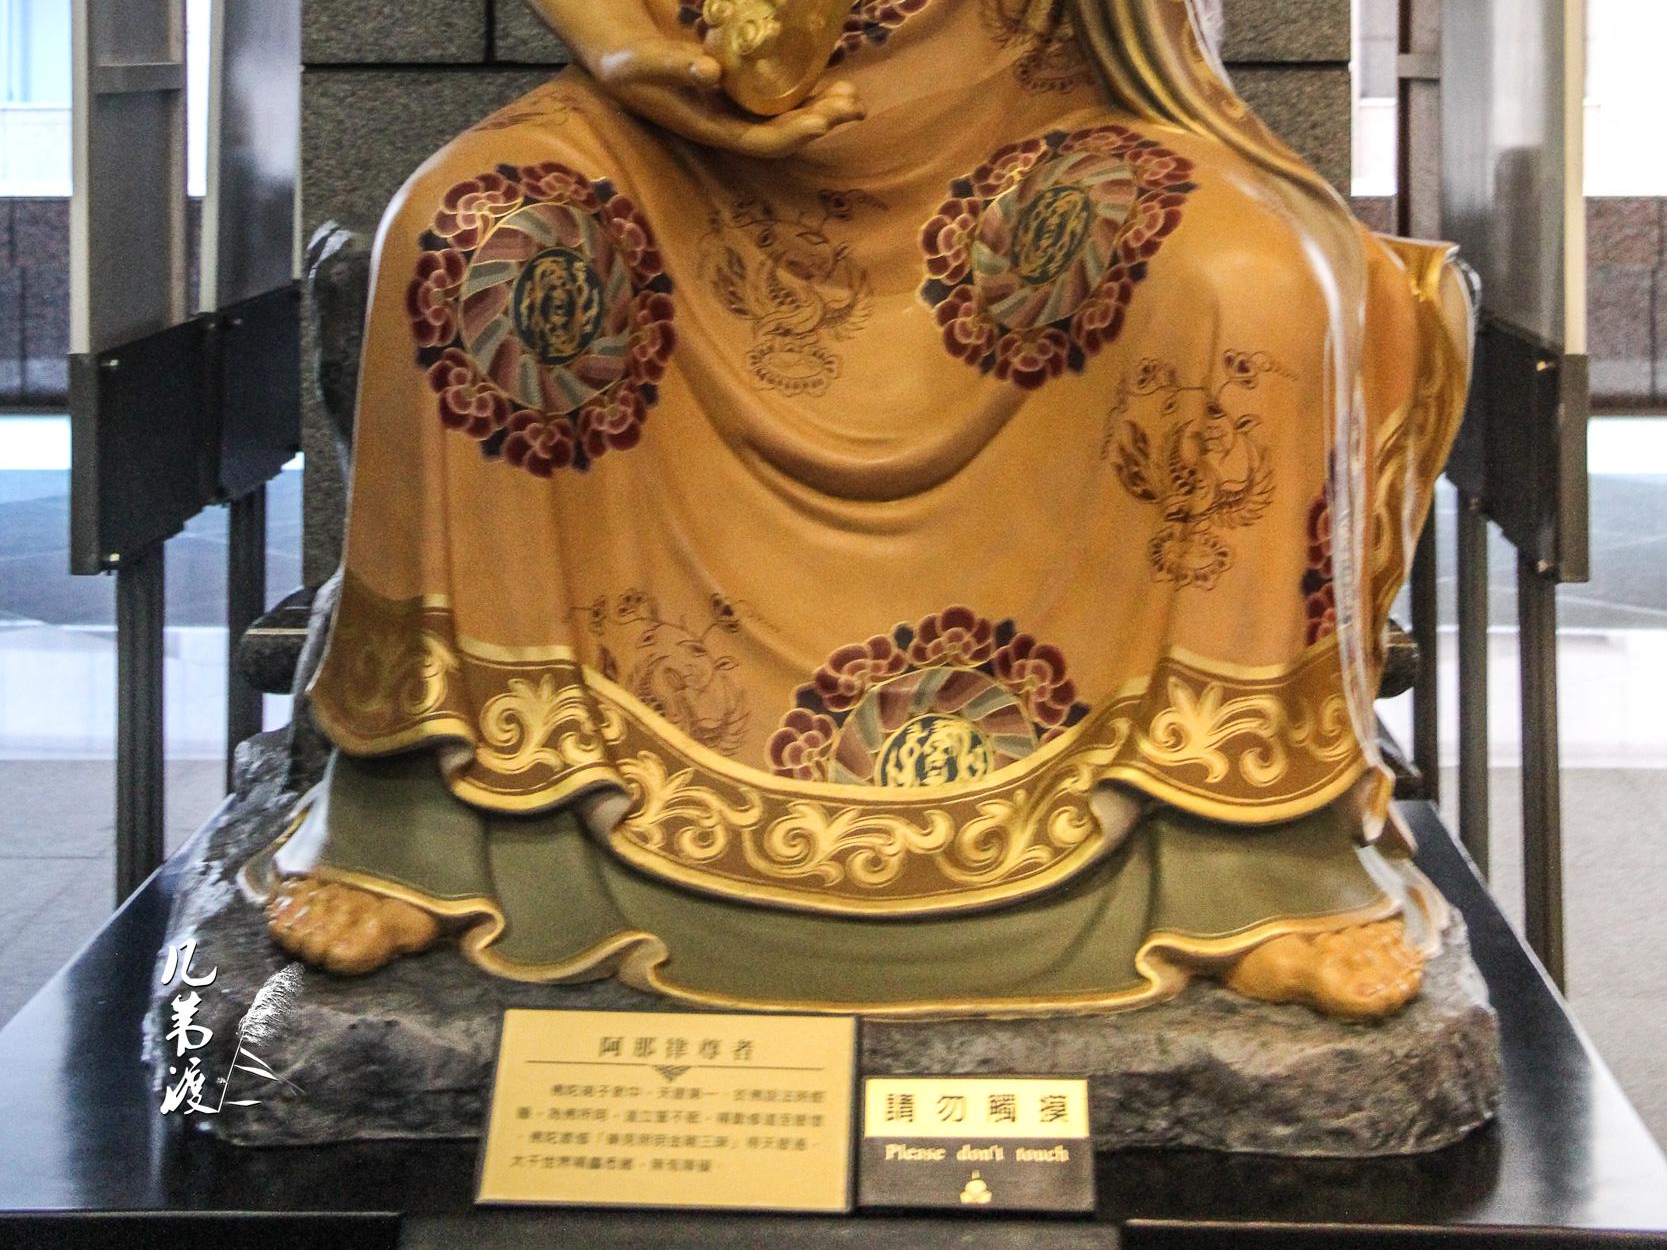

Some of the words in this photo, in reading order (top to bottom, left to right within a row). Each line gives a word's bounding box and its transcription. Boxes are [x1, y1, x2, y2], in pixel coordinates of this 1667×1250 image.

[885, 1093, 1070, 1123] 請勿觸摸
[885, 1143, 946, 1161] Please
[956, 1144, 1004, 1161] don't
[1015, 1145, 1069, 1162] touch
